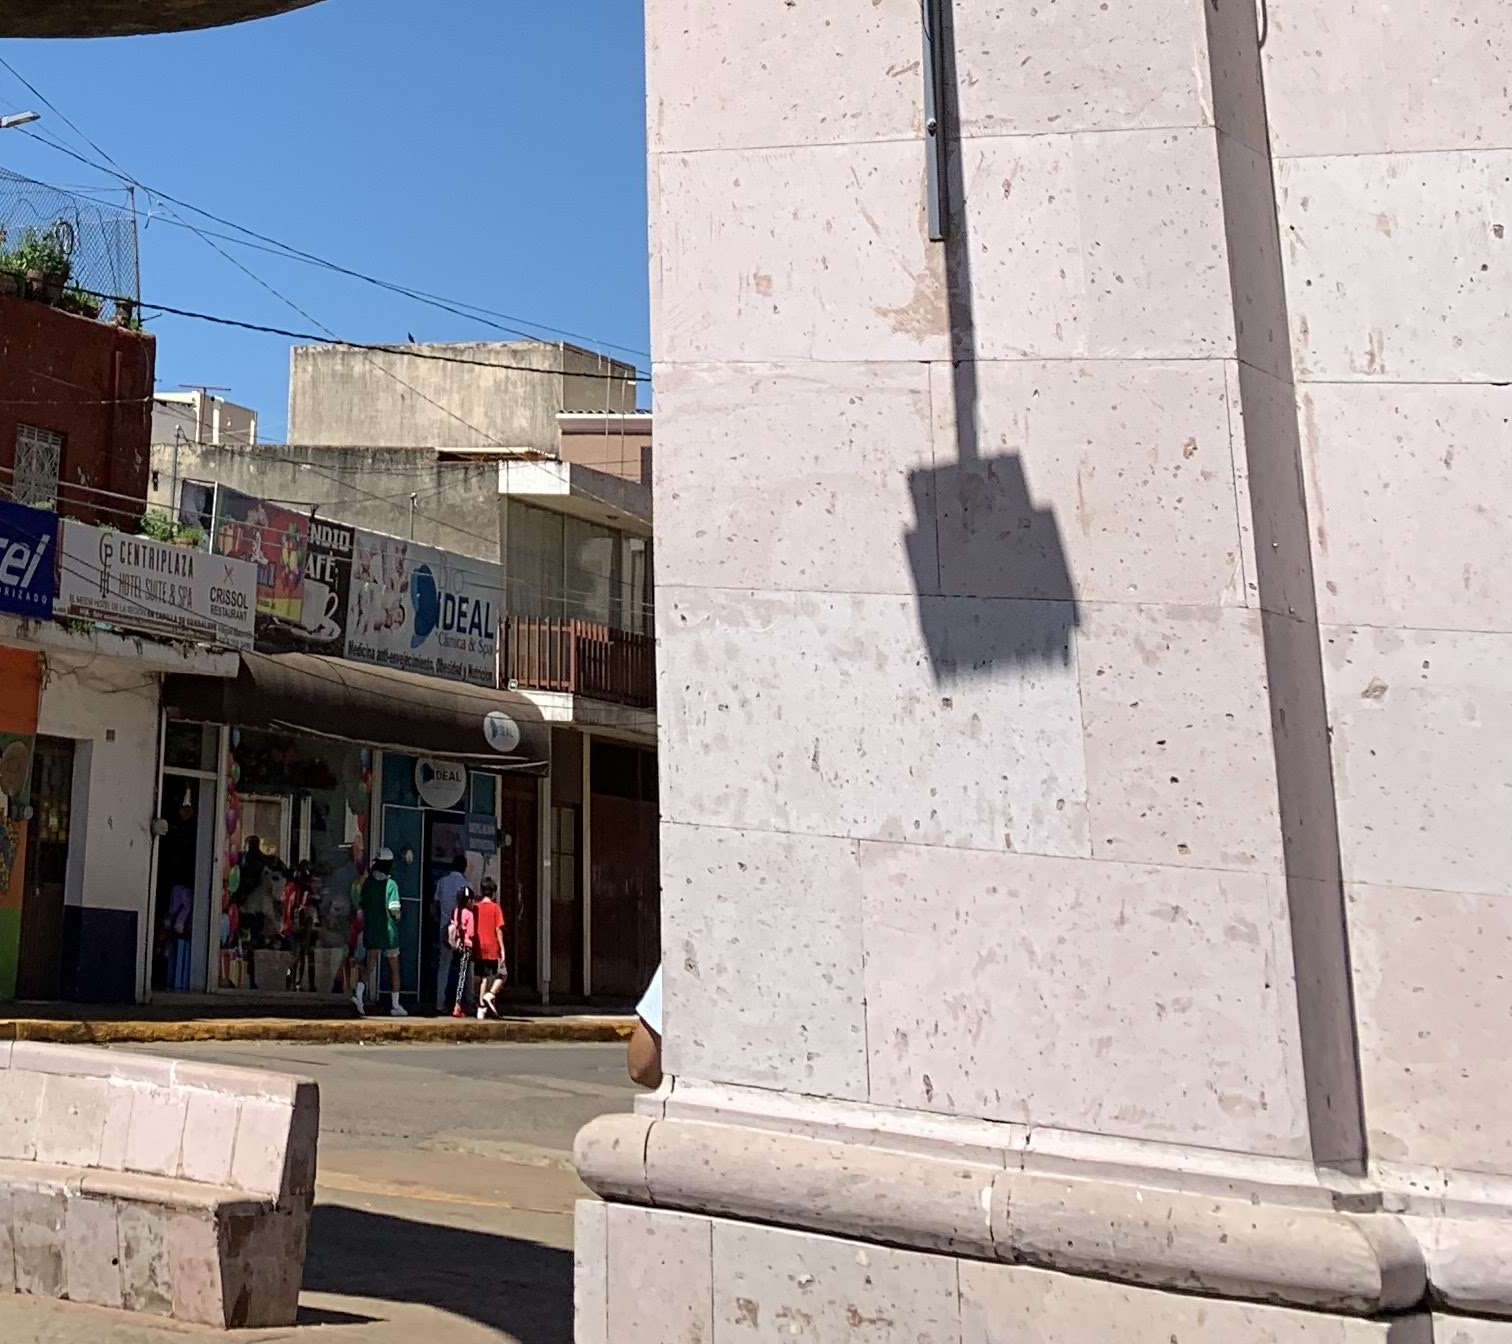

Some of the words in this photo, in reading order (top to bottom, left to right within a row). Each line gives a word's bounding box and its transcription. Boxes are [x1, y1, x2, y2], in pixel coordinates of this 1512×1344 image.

[119, 540, 194, 579] CENTRIPLAZA
[306, 551, 337, 583] AFÉ
[119, 572, 142, 599] HOTEL
[178, 585, 192, 609] SPA
[209, 586, 249, 610] CRISSOL
[210, 605, 248, 622] RESTAURANT
[436, 591, 494, 639] IDEAL
[478, 640, 494, 658] Spa
[432, 769, 462, 783] IDEAL
